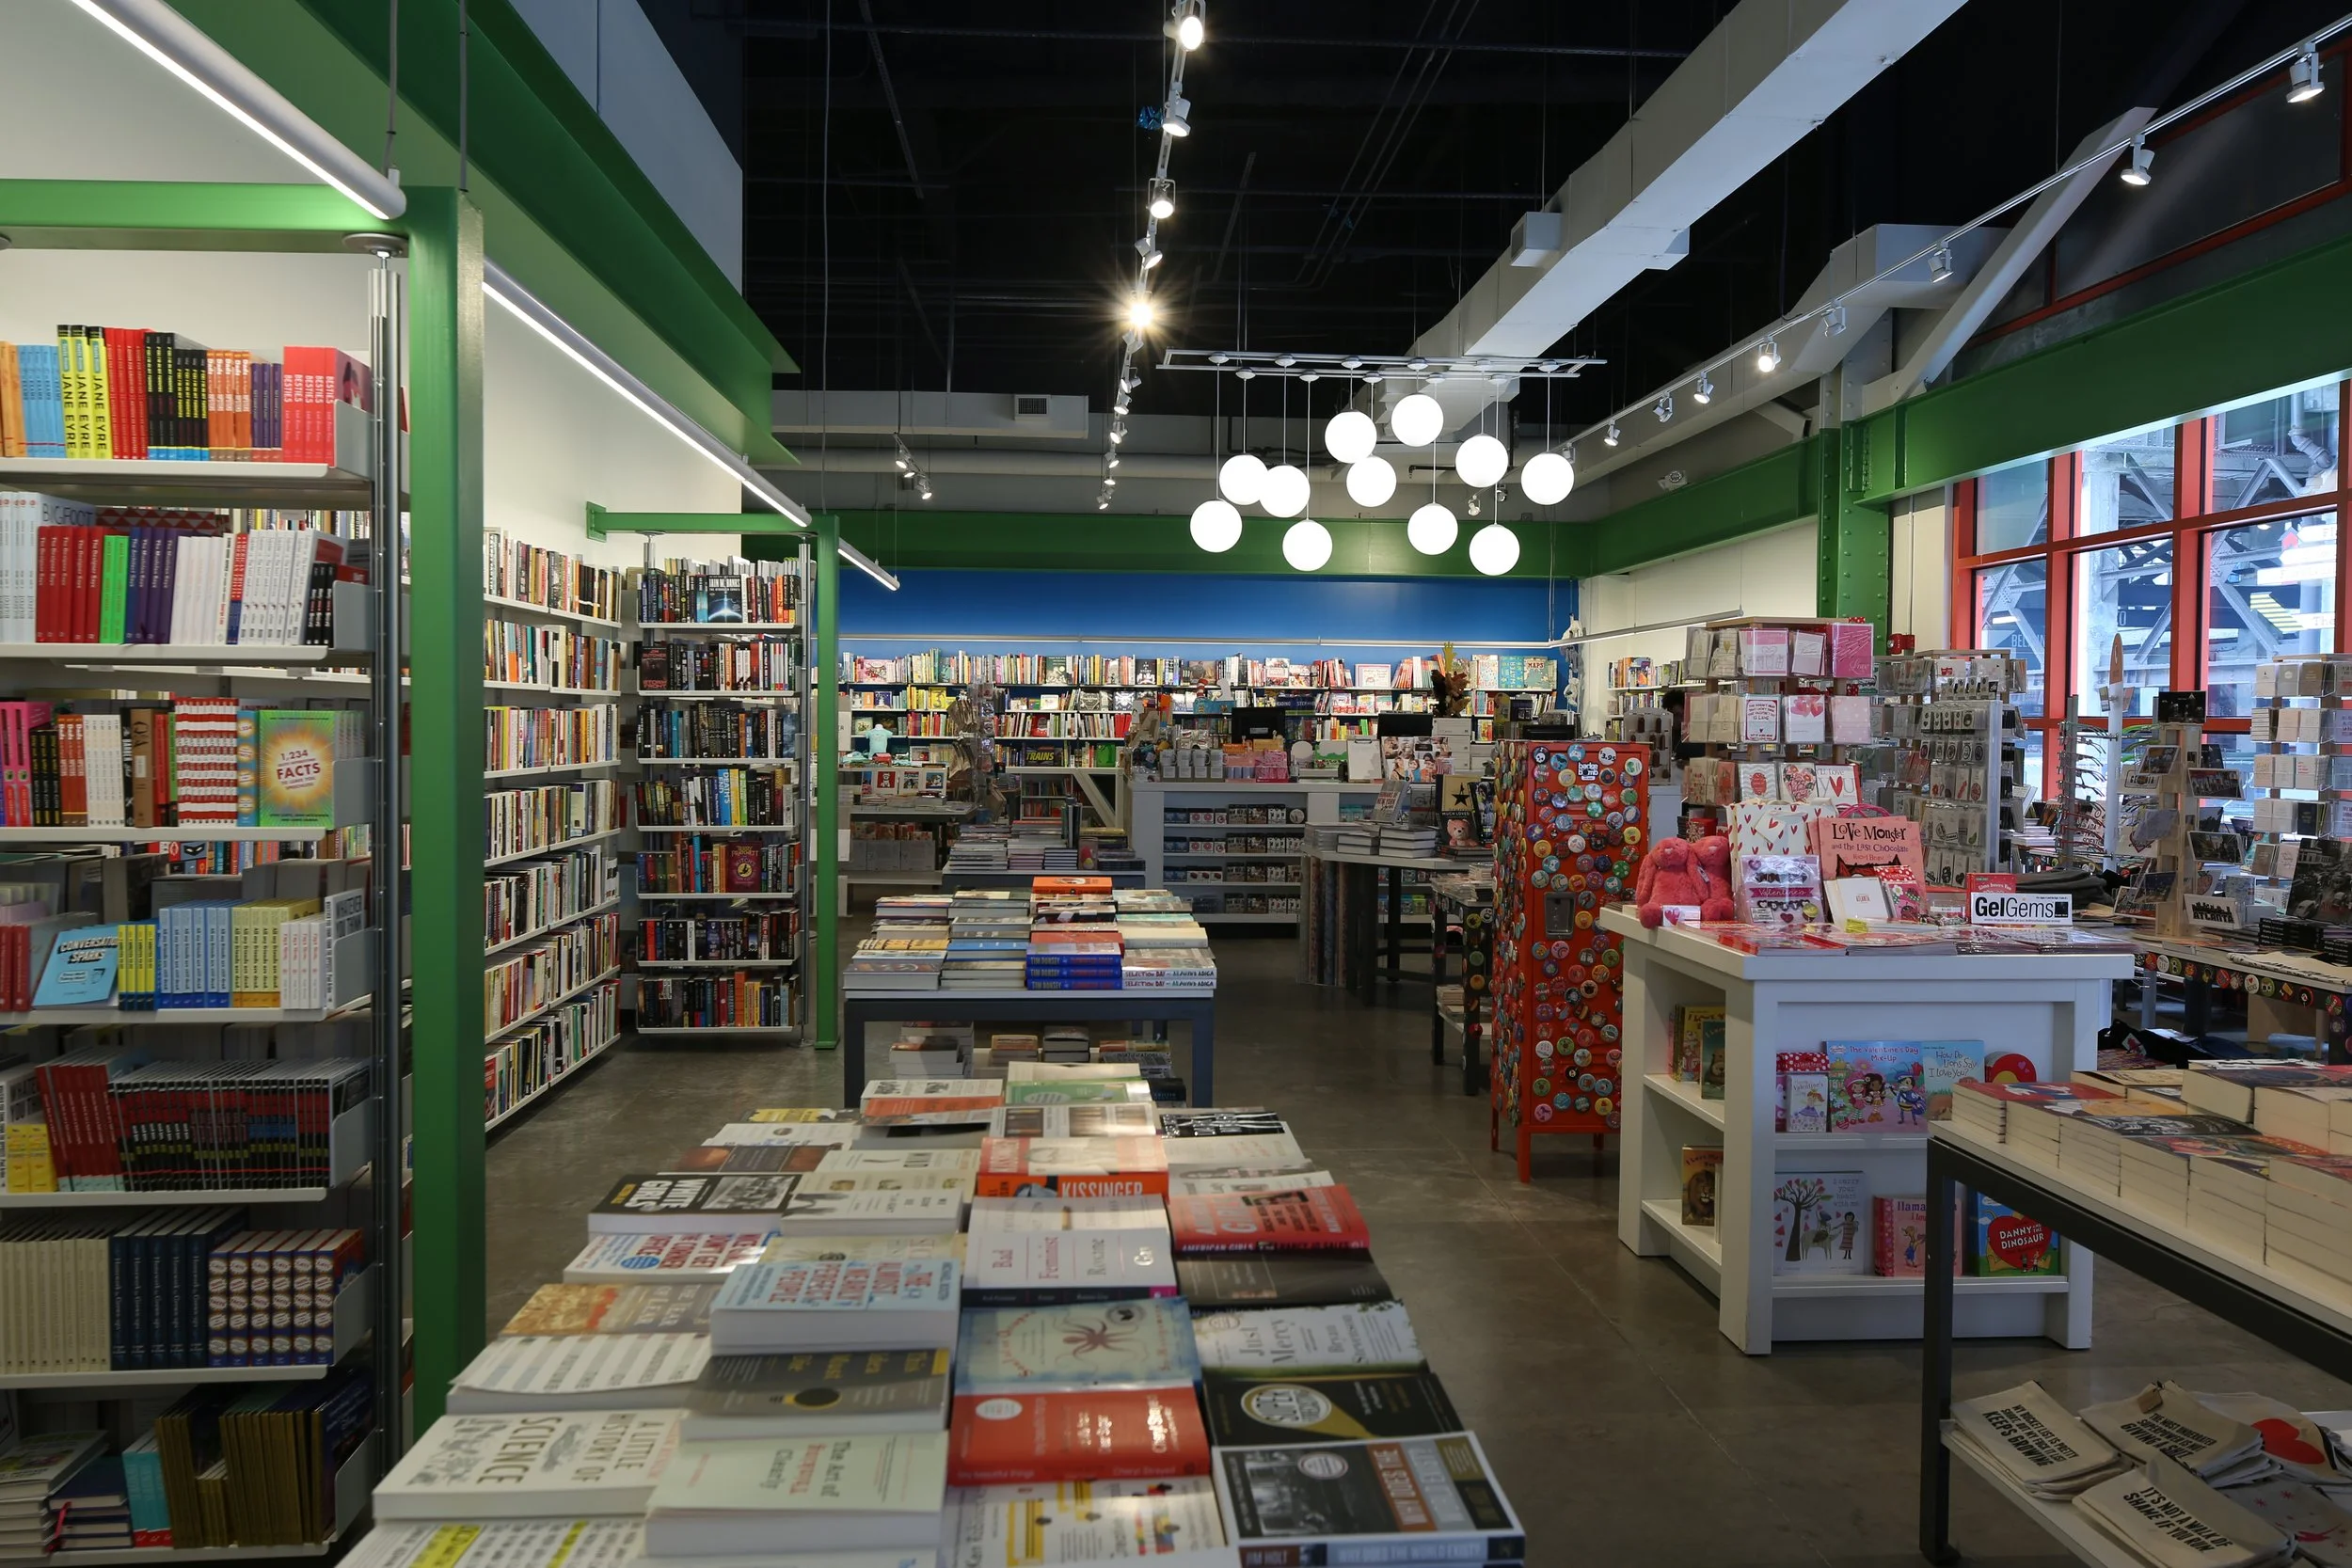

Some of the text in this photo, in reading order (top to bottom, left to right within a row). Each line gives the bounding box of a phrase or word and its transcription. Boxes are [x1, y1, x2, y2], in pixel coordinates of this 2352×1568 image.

[294, 374, 303, 402] BESTIES
[62, 374, 77, 450] JANE EYRE
[77, 374, 90, 449] JANE EYRE
[94, 376, 107, 450] JANE EYRE
[43, 503, 93, 527] BIGFOOT
[280, 750, 309, 761] 1,234
[1025, 752, 1055, 761] TRAINS
[277, 763, 321, 781] FACTS
[1976, 896, 2054, 918] GelGems
[2193, 911, 2233, 923] ATLANTA
[68, 950, 105, 964] SPARKS
[1871, 1054, 1897, 1063] Mix-Up
[1936, 1051, 1952, 1059] How
[1943, 1058, 1978, 1069] Lions Say
[1951, 1069, 1968, 1078] You?
[625, 1180, 673, 1210] GIRLS
[660, 1179, 707, 1209] WHITE
[1061, 1181, 1142, 1196] KISSINGER
[1898, 1201, 1926, 1211] llama
[1182, 1243, 1227, 1252] AMERICAN
[1999, 1226, 2032, 1240] DANNY
[2001, 1233, 2044, 1249] DINOSAUR
[659, 1242, 697, 1269] CORNER
[691, 1234, 735, 1268] DON'T GET
[992, 1249, 1013, 1268] Bad
[1039, 1236, 1058, 1279] Feminist
[1088, 1239, 1106, 1275] Roxane
[768, 1270, 808, 1303] PEOPLE
[804, 1264, 842, 1300] PERFECT
[836, 1269, 869, 1300] NEARLY
[872, 1262, 902, 1295] ALMOST
[632, 1297, 669, 1326] LEAR
[657, 1285, 701, 1326] THE YEAR
[1239, 1327, 1264, 1356] Just
[1270, 1319, 1295, 1363] Mercy
[1326, 1324, 1344, 1354] Bryan
[1343, 1314, 1367, 1363] Stevenson
[544, 1354, 580, 1390] FUTURE
[823, 1354, 852, 1379] Must
[864, 1353, 887, 1375] Idea
[904, 1352, 928, 1372] This
[1982, 1411, 2054, 1466] KEEPS GROWING
[2012, 1404, 2026, 1413] MY
[2021, 1412, 2047, 1429] BUCKET
[2038, 1428, 2055, 1439] LIST
[2055, 1442, 2079, 1458] PRETTY
[2016, 1422, 2031, 1432] BUT
[2033, 1438, 2051, 1449] FUCK
[2051, 1453, 2066, 1462] LIST
[2121, 1423, 2194, 1459] GIVING A SHIT
[2137, 1419, 2185, 1444] SUPERPOWER
[2187, 1443, 2206, 1452] NOT
[2149, 1413, 2217, 1446] THE MOST UNDERRATED
[476, 1417, 562, 1483] SCIENCE
[572, 1414, 634, 1482] HISTORY OF
[613, 1432, 655, 1469] LITTLE
[1374, 1449, 1400, 1470] THE
[759, 1449, 794, 1489] Clearly
[822, 1440, 851, 1497] The Art of
[2123, 1492, 2215, 1553] SHAME IF YOU RUN
[2140, 1486, 2233, 1547] IT'S NOT A WALK OF
[1246, 1552, 1263, 1565] JIM
[1264, 1550, 1288, 1564] HOLT
[1391, 1546, 1409, 1561] THE
[1411, 1545, 1445, 1560] WORLD
